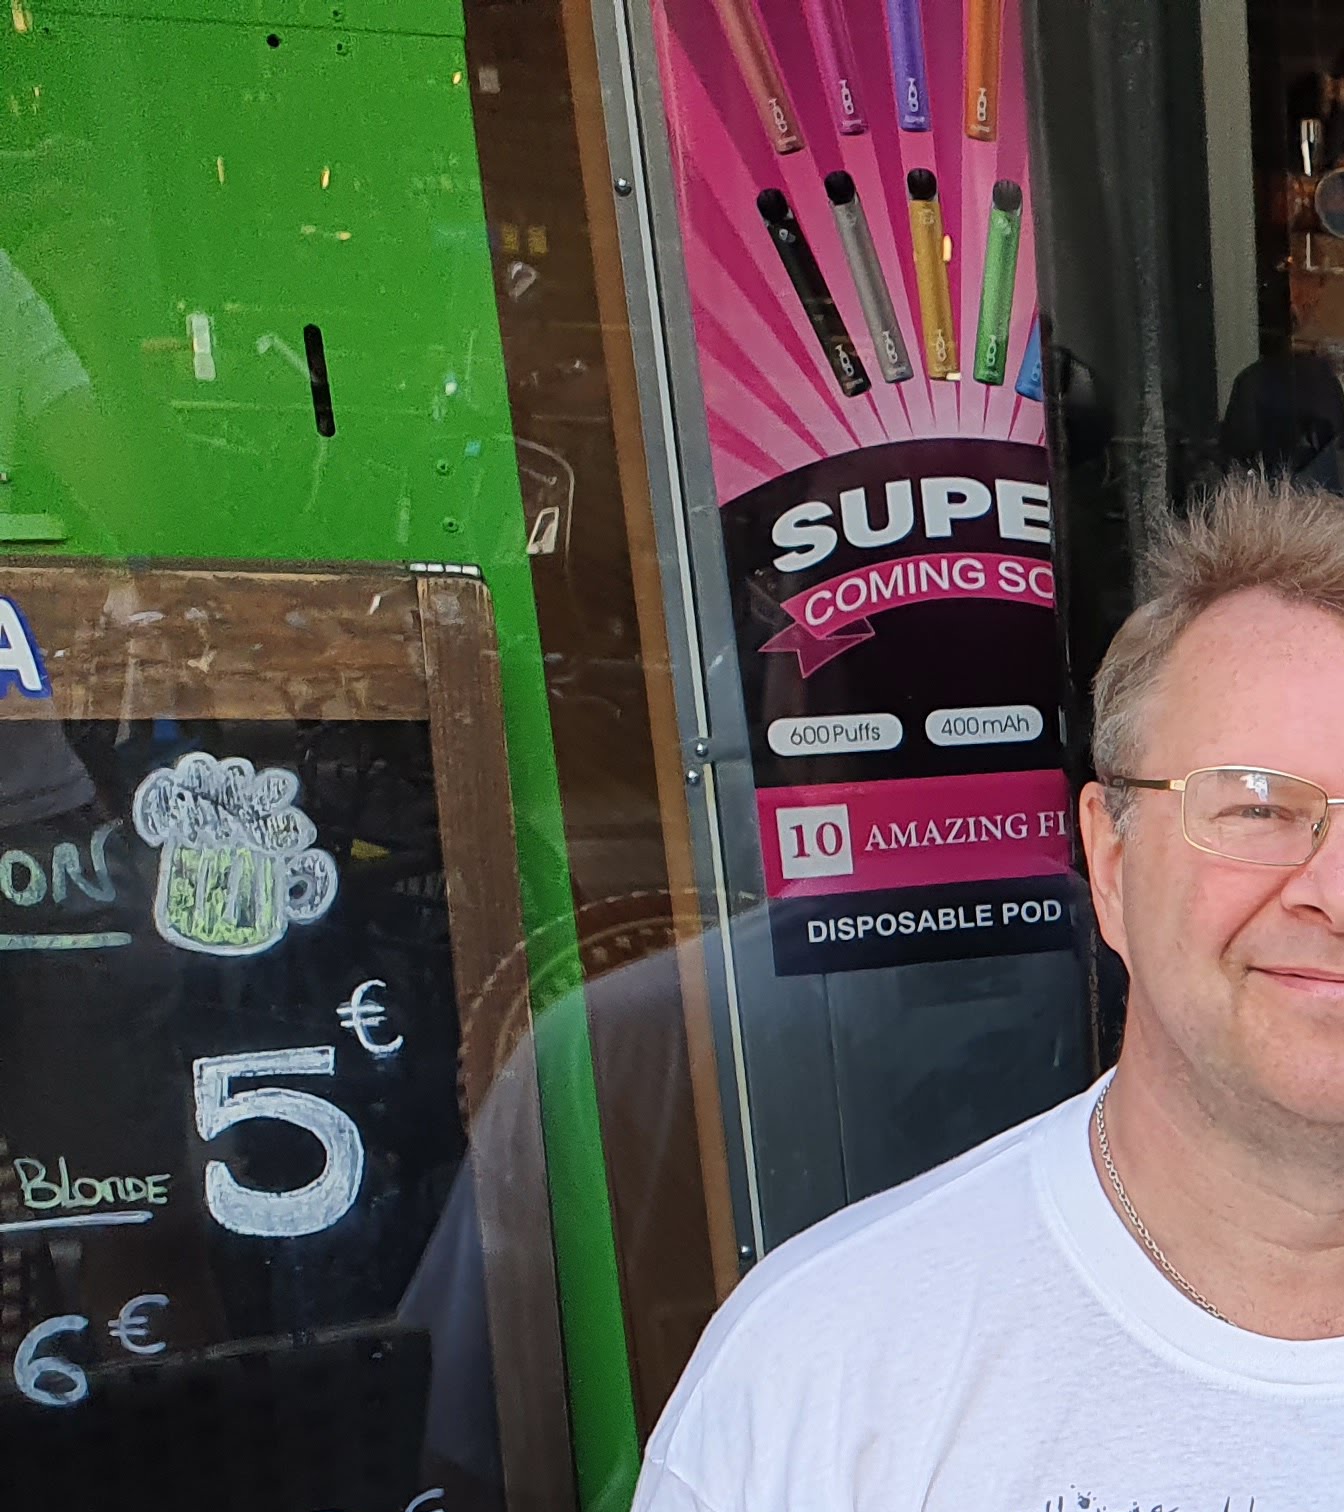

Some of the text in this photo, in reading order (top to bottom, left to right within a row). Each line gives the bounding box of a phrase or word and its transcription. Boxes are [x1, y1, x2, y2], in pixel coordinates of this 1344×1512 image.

[804, 557, 986, 627] COMING
[788, 820, 843, 860] 10
[864, 813, 1028, 851] AMAZING
[807, 899, 1063, 944] DISPOSABLE POD
